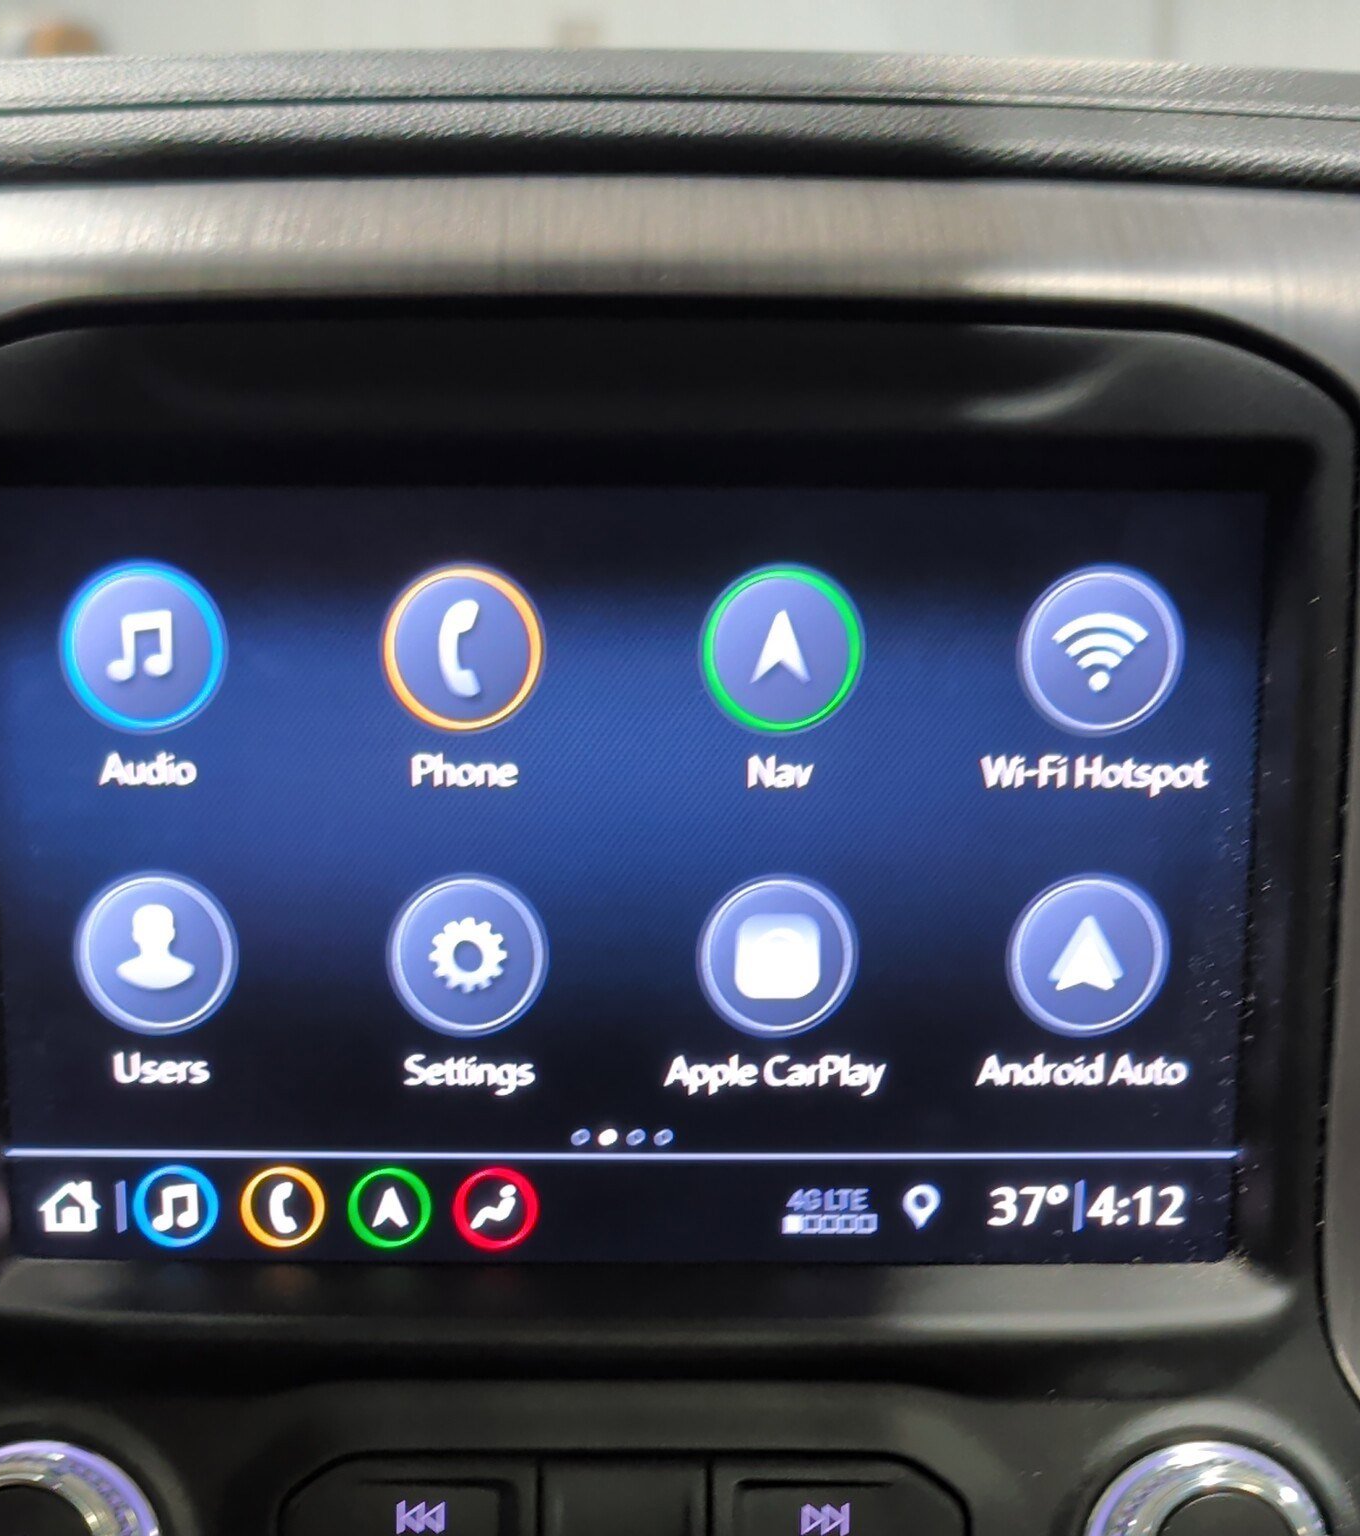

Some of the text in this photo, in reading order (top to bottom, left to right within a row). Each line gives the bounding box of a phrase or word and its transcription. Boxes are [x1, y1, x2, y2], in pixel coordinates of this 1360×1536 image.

[100, 753, 198, 786] Audio
[412, 754, 519, 788] Phone
[749, 756, 814, 789] Nav
[982, 756, 1210, 798] Wi-Fi Hotspot
[114, 1053, 211, 1085] Users
[405, 1055, 536, 1097] Settings
[665, 1055, 887, 1097] Apple CarPlay
[977, 1054, 1188, 1087] Android Auto
[825, 1190, 869, 1212] LTE
[1088, 1187, 1186, 1226] 4:12
